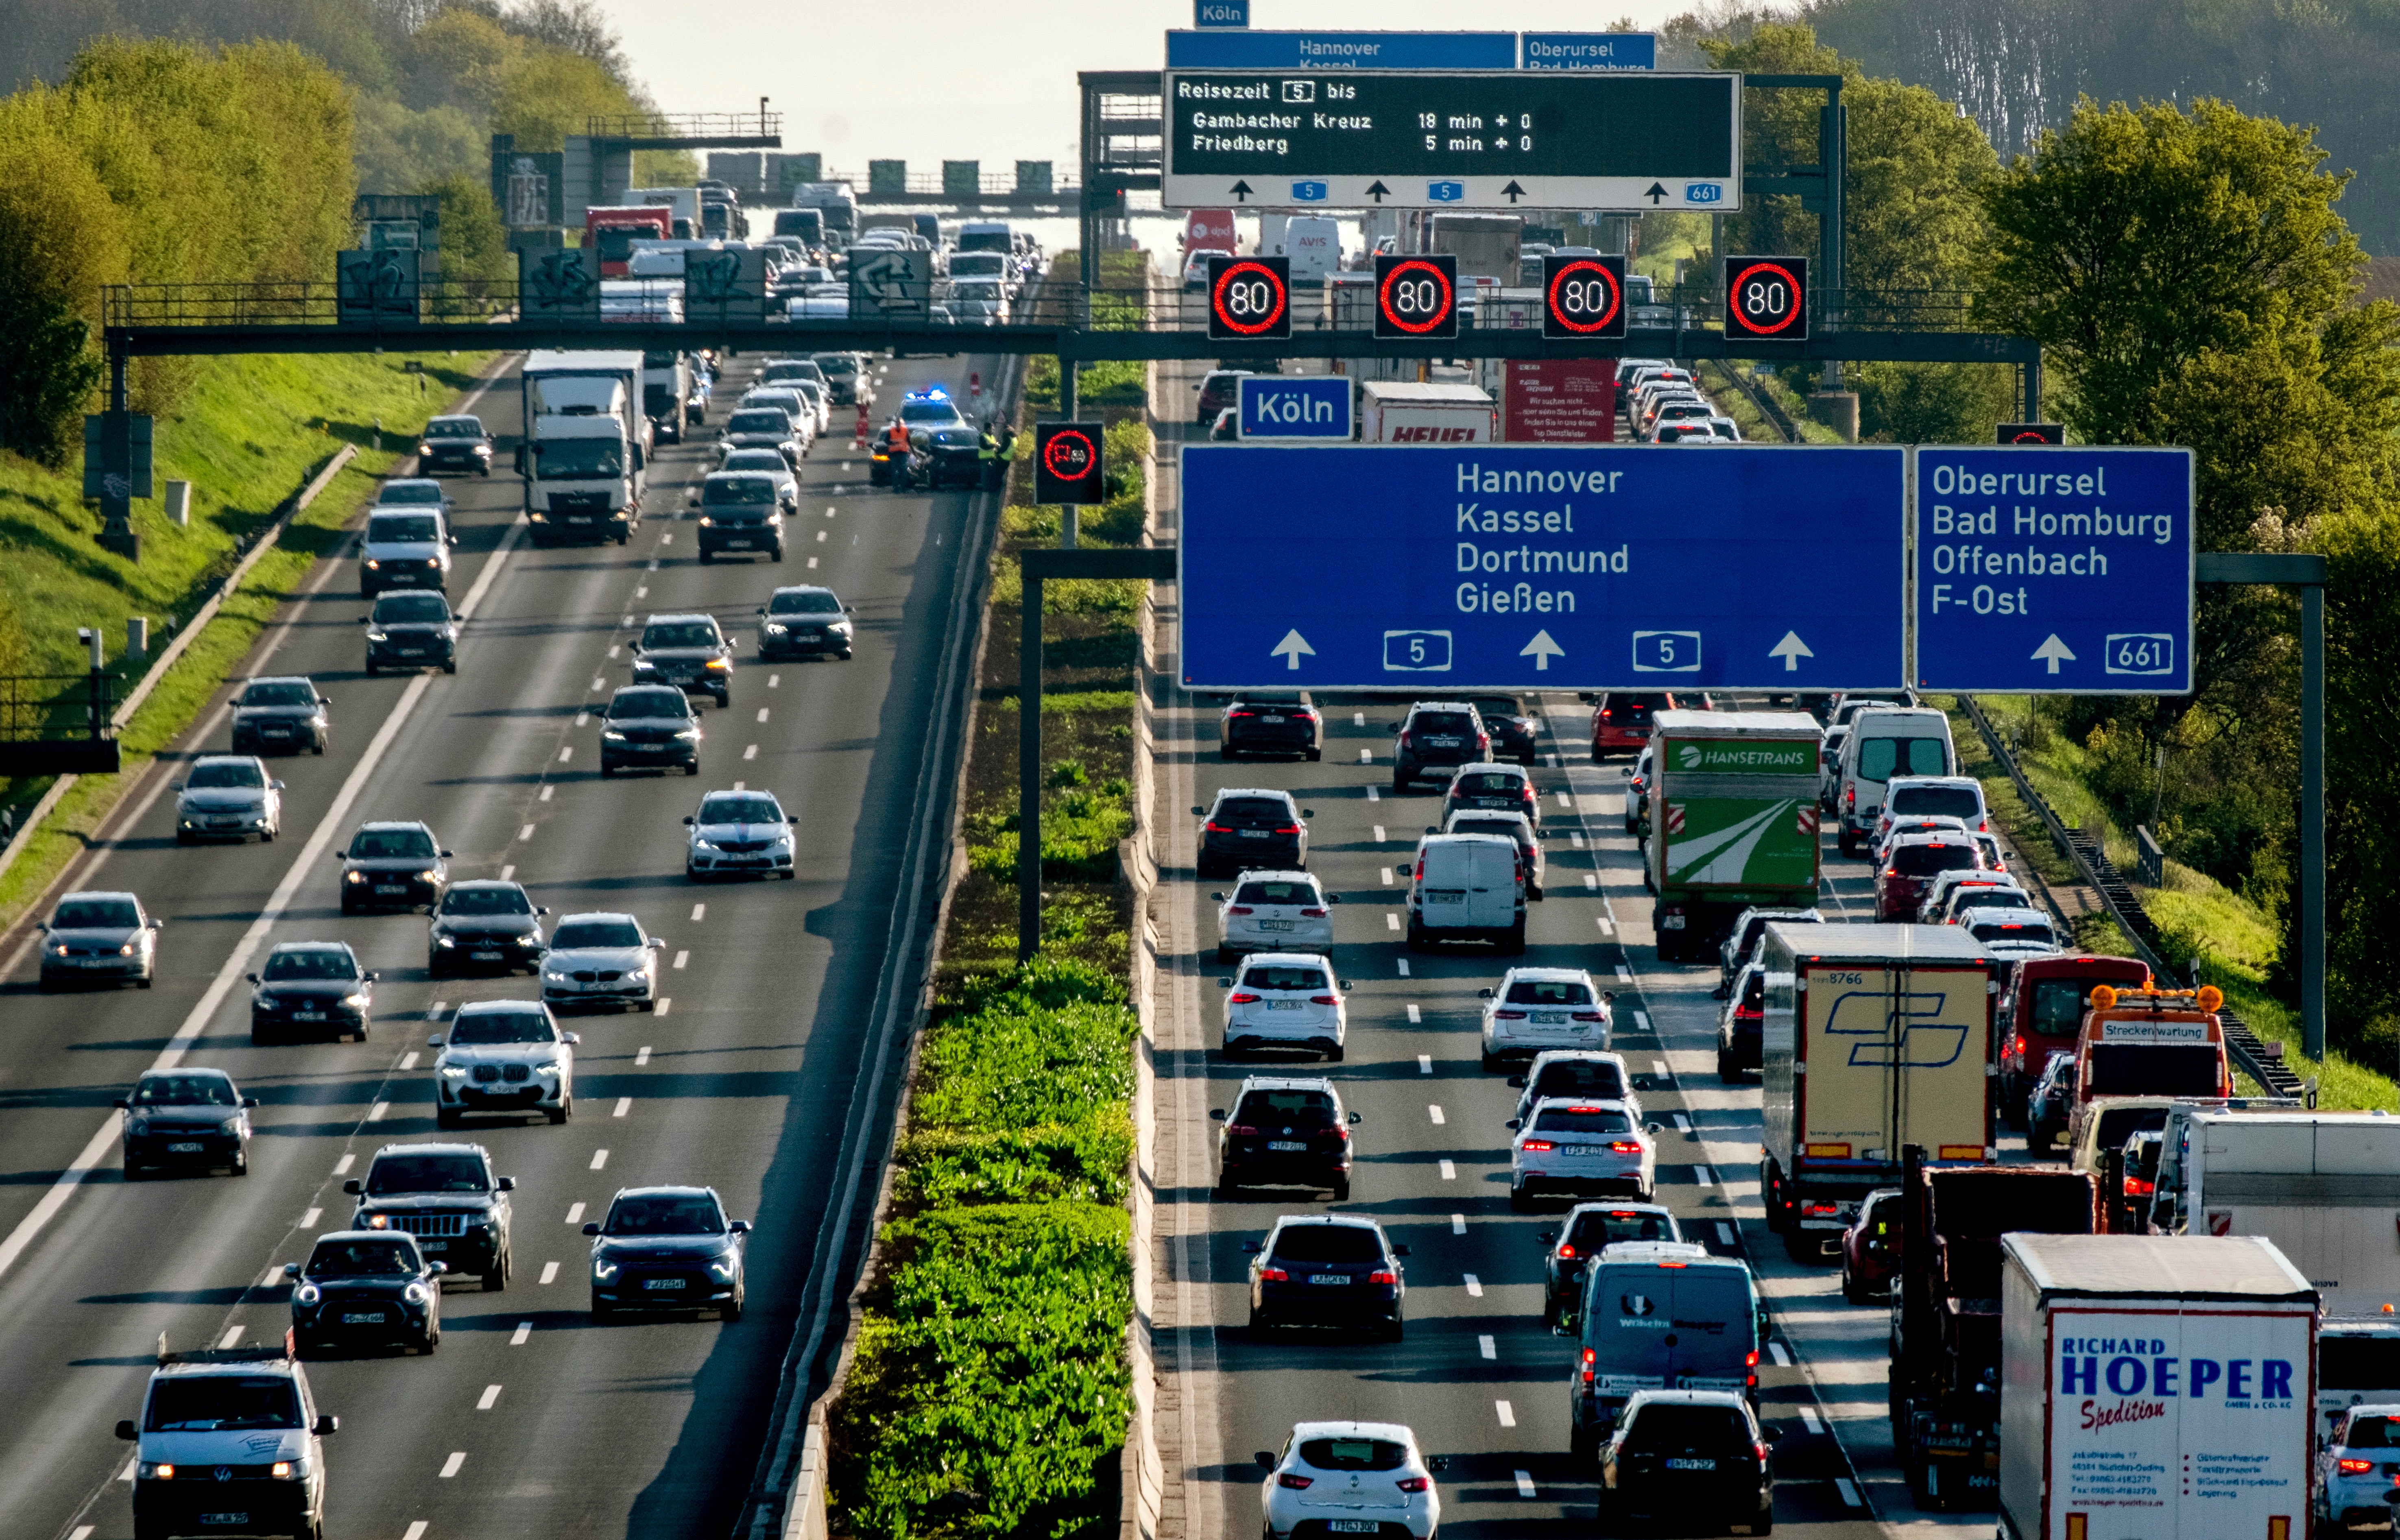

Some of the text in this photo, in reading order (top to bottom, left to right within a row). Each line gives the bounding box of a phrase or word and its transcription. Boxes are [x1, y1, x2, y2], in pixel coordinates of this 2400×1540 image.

[1203, 6, 1241, 20] Köln
[1300, 40, 1381, 55] Hannover
[1530, 41, 1614, 57] Oberursel
[1179, 82, 1355, 100] Reisezeit 5 bis
[1193, 112, 1301, 129] Gambacher
[1314, 113, 1372, 129] Kreuz
[1419, 113, 1436, 129] 18
[1449, 113, 1481, 129] min
[1521, 113, 1530, 129] 0
[1193, 134, 1287, 155] Friedberg
[1426, 135, 1436, 151] 5
[1449, 135, 1483, 151] min
[1521, 135, 1531, 151] 0
[1305, 184, 1314, 198] 5
[1442, 184, 1451, 198] 5
[1692, 185, 1716, 200] 661
[1211, 225, 1230, 238] dpd
[1298, 236, 1327, 247] AVIS
[1230, 281, 1269, 315] 80
[1397, 280, 1435, 312] 80
[1565, 280, 1604, 313] 80
[1747, 282, 1784, 314] 80
[1258, 393, 1333, 423] Köln
[1457, 463, 1623, 493] Hannover
[1933, 465, 2106, 495] Oberursel
[1457, 503, 1573, 532] Kassel
[1933, 505, 2171, 544] Bad Homburg
[1457, 542, 1628, 573] Dortmund
[1933, 545, 2107, 575] Offenbach
[1457, 582, 1575, 613] Gießen
[1933, 585, 2027, 615] F-Ost
[1410, 639, 1425, 662] 5
[1660, 639, 1674, 663] 5
[2119, 641, 2161, 667] 661
[1705, 751, 1804, 764] HANSETRANS
[1829, 973, 1862, 985] 8766
[2105, 1024, 2202, 1039] Streckenwartung
[2062, 1338, 2166, 1355] RICHARD
[2061, 1356, 2293, 1399] HOEPER
[2081, 1398, 2166, 1435] Spedition
